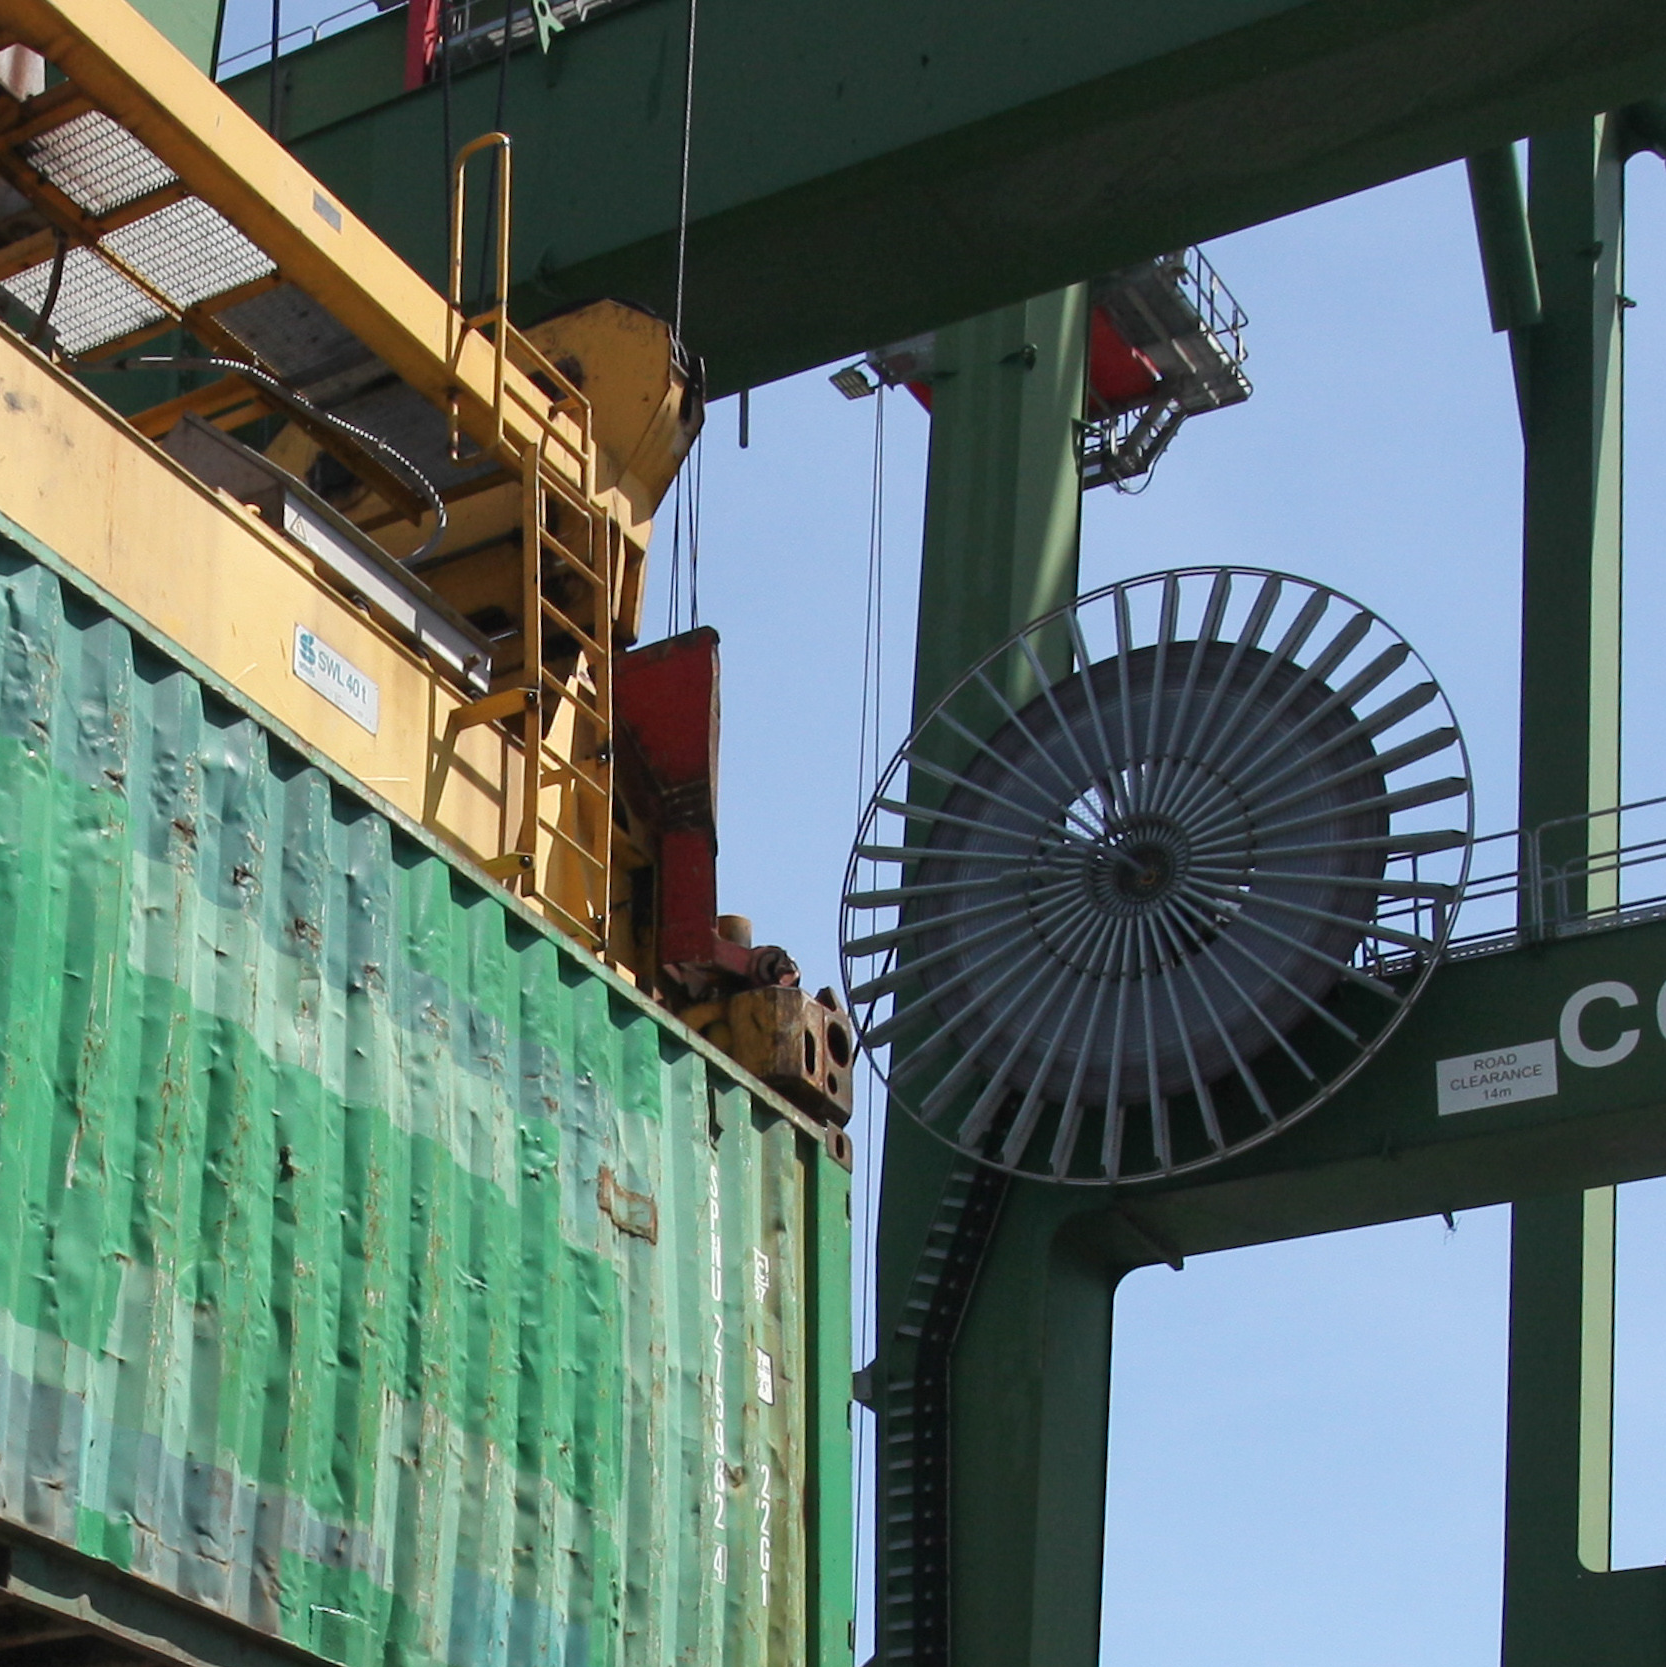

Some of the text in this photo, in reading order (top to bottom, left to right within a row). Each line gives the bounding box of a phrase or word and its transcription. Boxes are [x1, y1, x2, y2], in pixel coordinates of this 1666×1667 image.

[318, 651, 367, 704] SWL 40 t
[1473, 1052, 1517, 1071] ROAD
[1450, 1064, 1542, 1092] CLEARANCE
[1483, 1085, 1512, 1100] 14m
[759, 1464, 771, 1607] 22G1
[712, 1546, 724, 1581] 4
